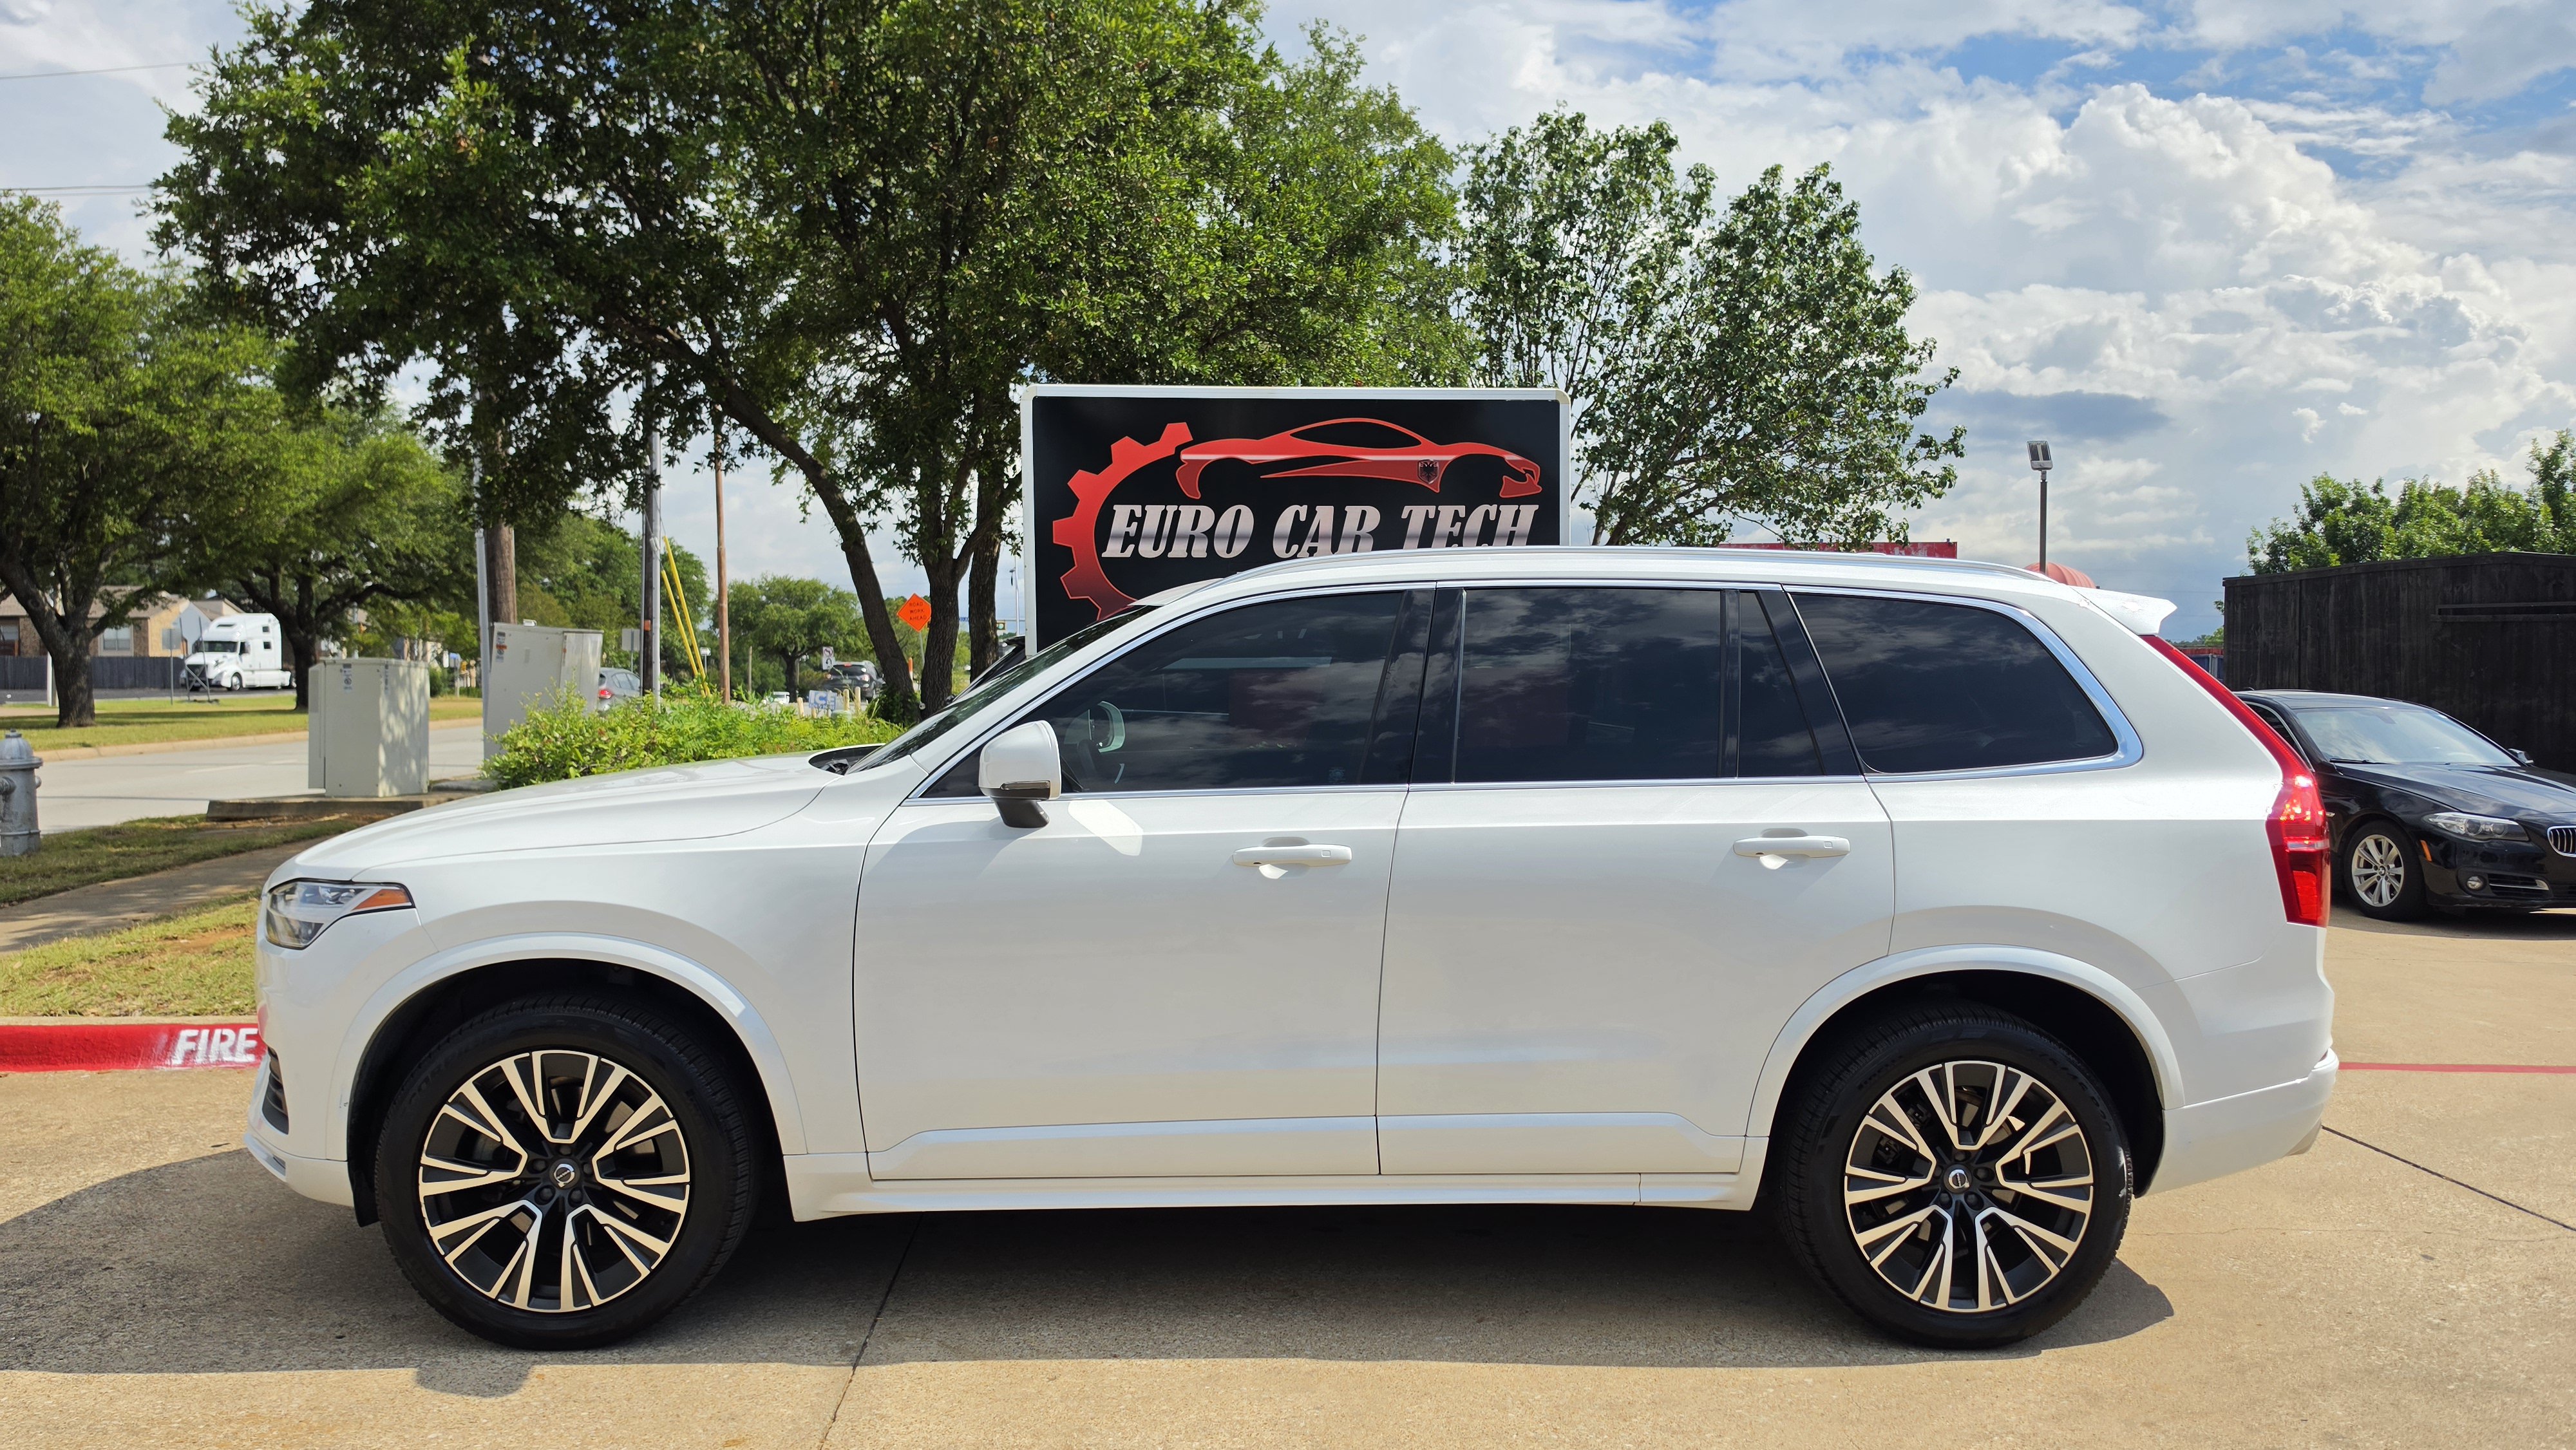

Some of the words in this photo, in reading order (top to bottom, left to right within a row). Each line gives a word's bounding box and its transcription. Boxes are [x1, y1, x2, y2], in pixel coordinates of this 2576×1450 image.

[1101, 504, 1255, 559] EURO
[1273, 505, 1381, 559] CAR
[1401, 504, 1539, 550] TECH
[810, 690, 836, 706] ICE
[169, 1028, 258, 1065] FIRE
